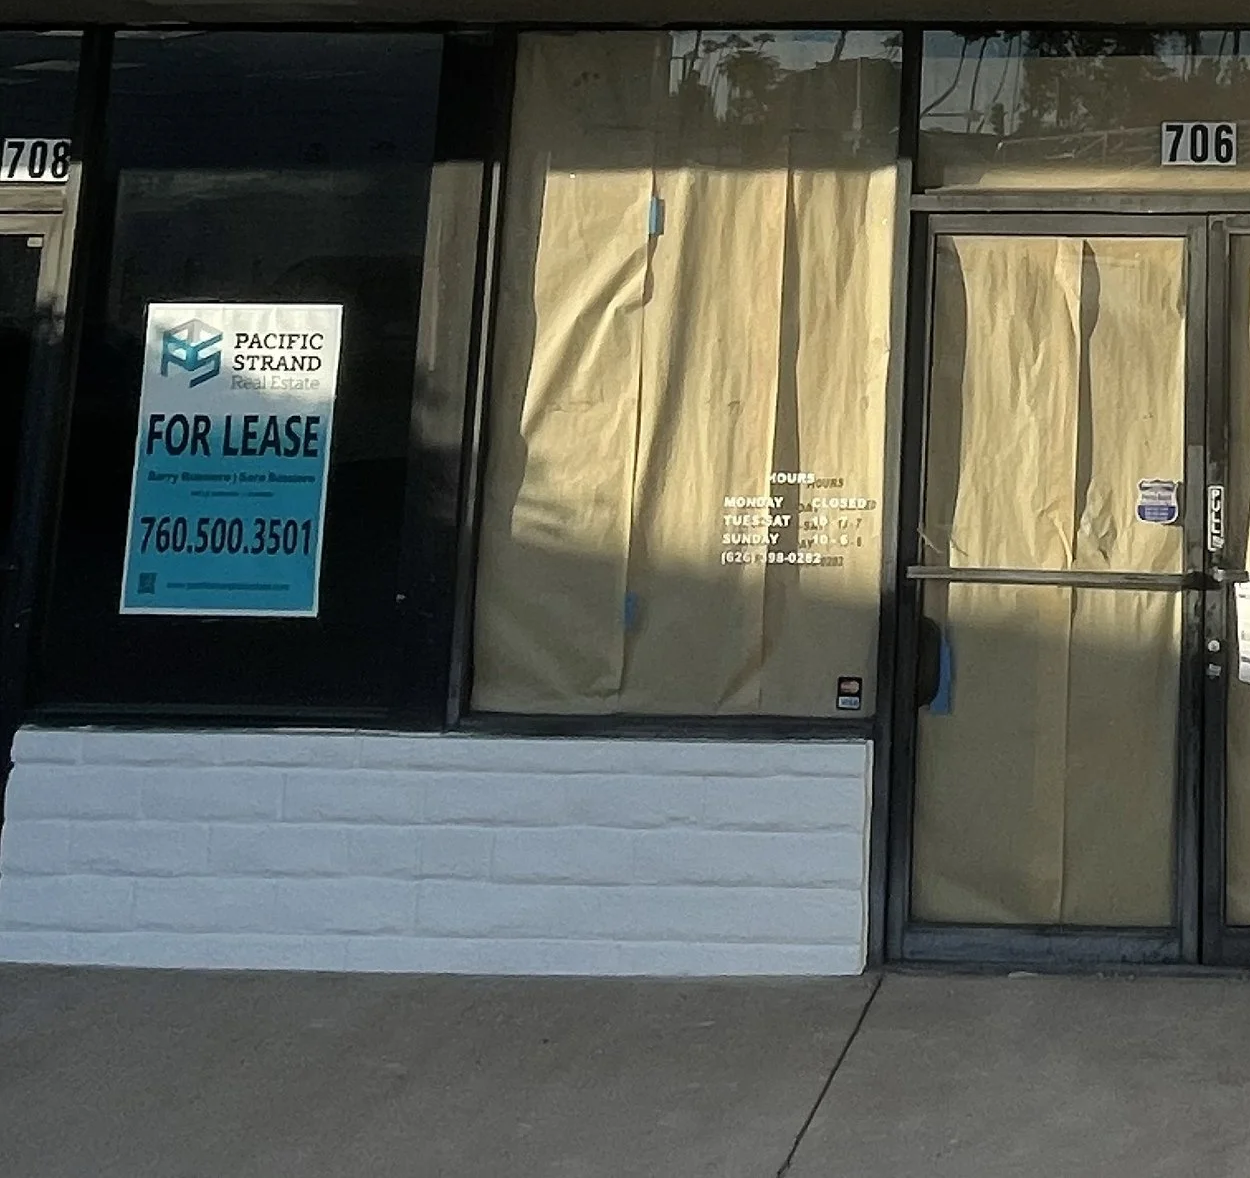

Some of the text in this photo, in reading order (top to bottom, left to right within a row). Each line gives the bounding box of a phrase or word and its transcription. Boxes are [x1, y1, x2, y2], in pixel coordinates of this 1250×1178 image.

[1165, 124, 1233, 163] 706
[7, 141, 70, 178] 708
[234, 333, 324, 350] PACIFIC
[232, 355, 321, 372] STRAND
[230, 375, 320, 391] Real Estate
[146, 413, 321, 458] FOR LEASE
[768, 472, 816, 485] HOURS
[723, 496, 867, 509] MONDAY CLOSED
[1211, 489, 1221, 533] PULL
[140, 516, 312, 556] 760.500.3501
[721, 533, 780, 545] SUNDAY
